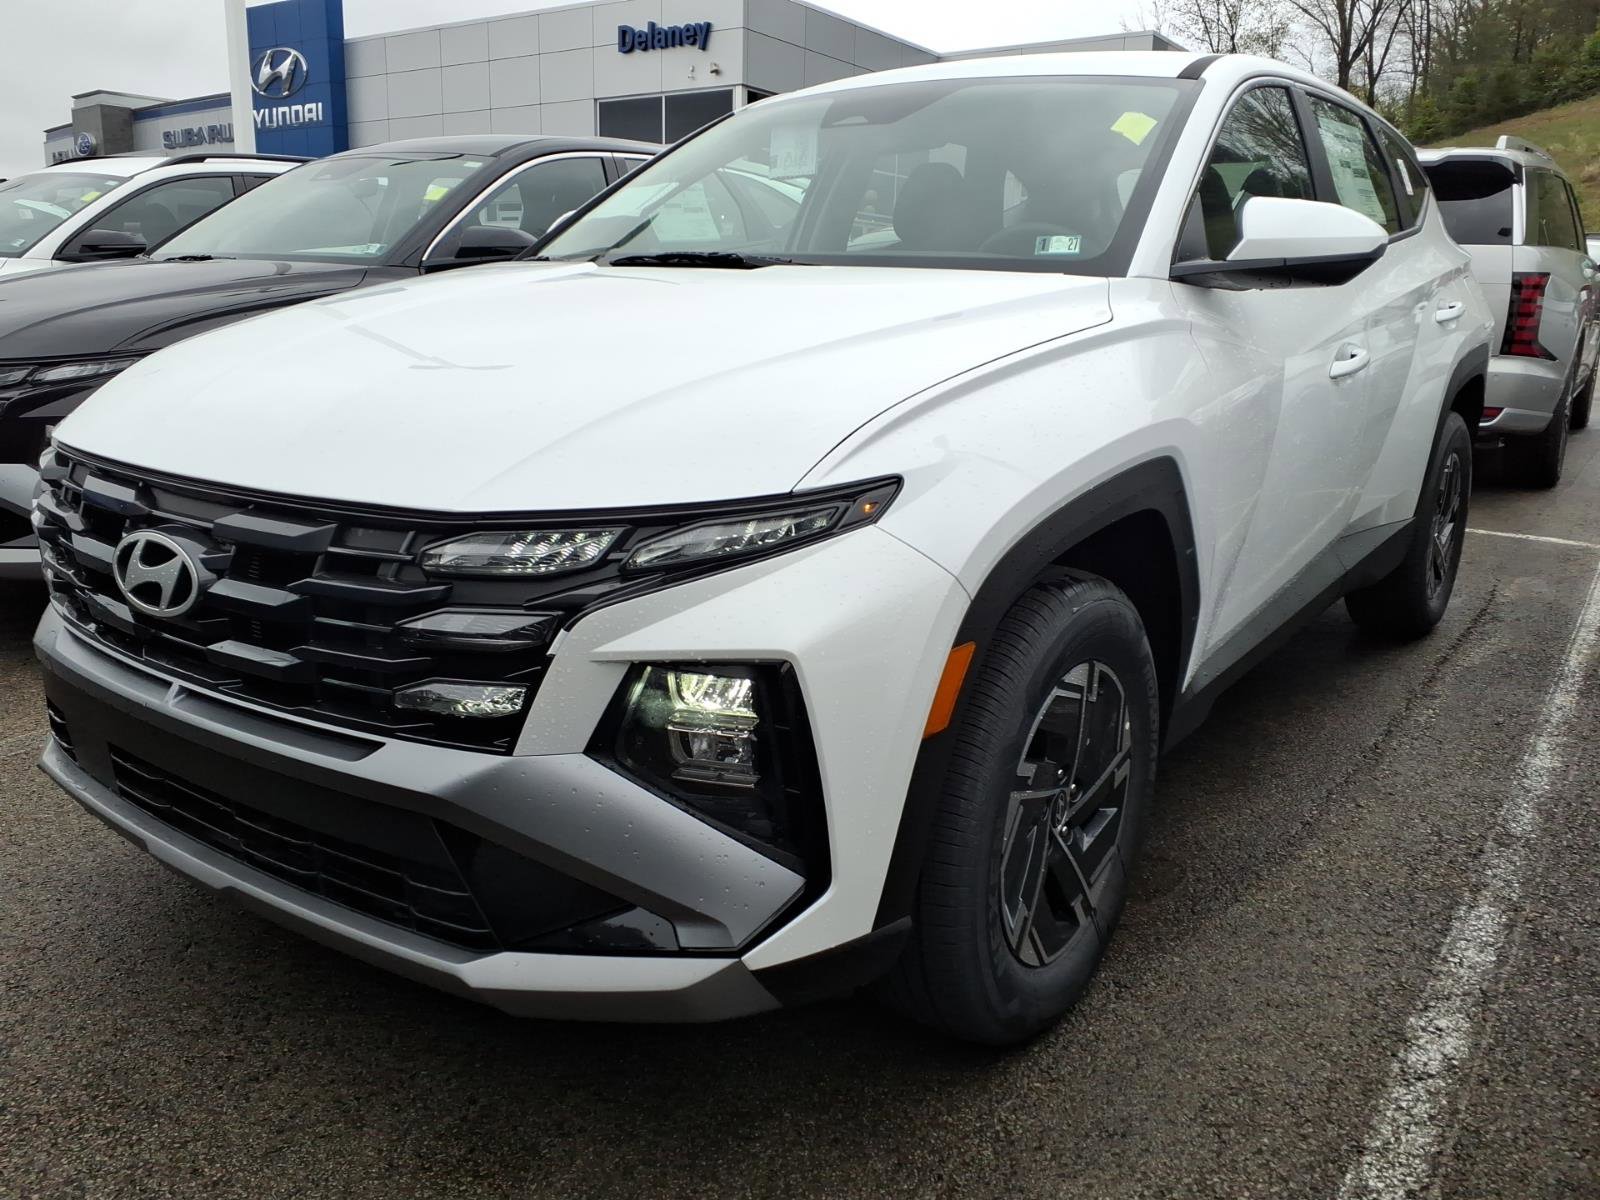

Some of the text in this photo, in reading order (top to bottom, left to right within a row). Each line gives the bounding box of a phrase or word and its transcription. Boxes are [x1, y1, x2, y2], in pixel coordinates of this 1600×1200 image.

[617, 21, 711, 53] Delaney
[252, 102, 323, 128] YUNDAI
[163, 123, 235, 149] SUBARU
[1067, 237, 1079, 251] 27
